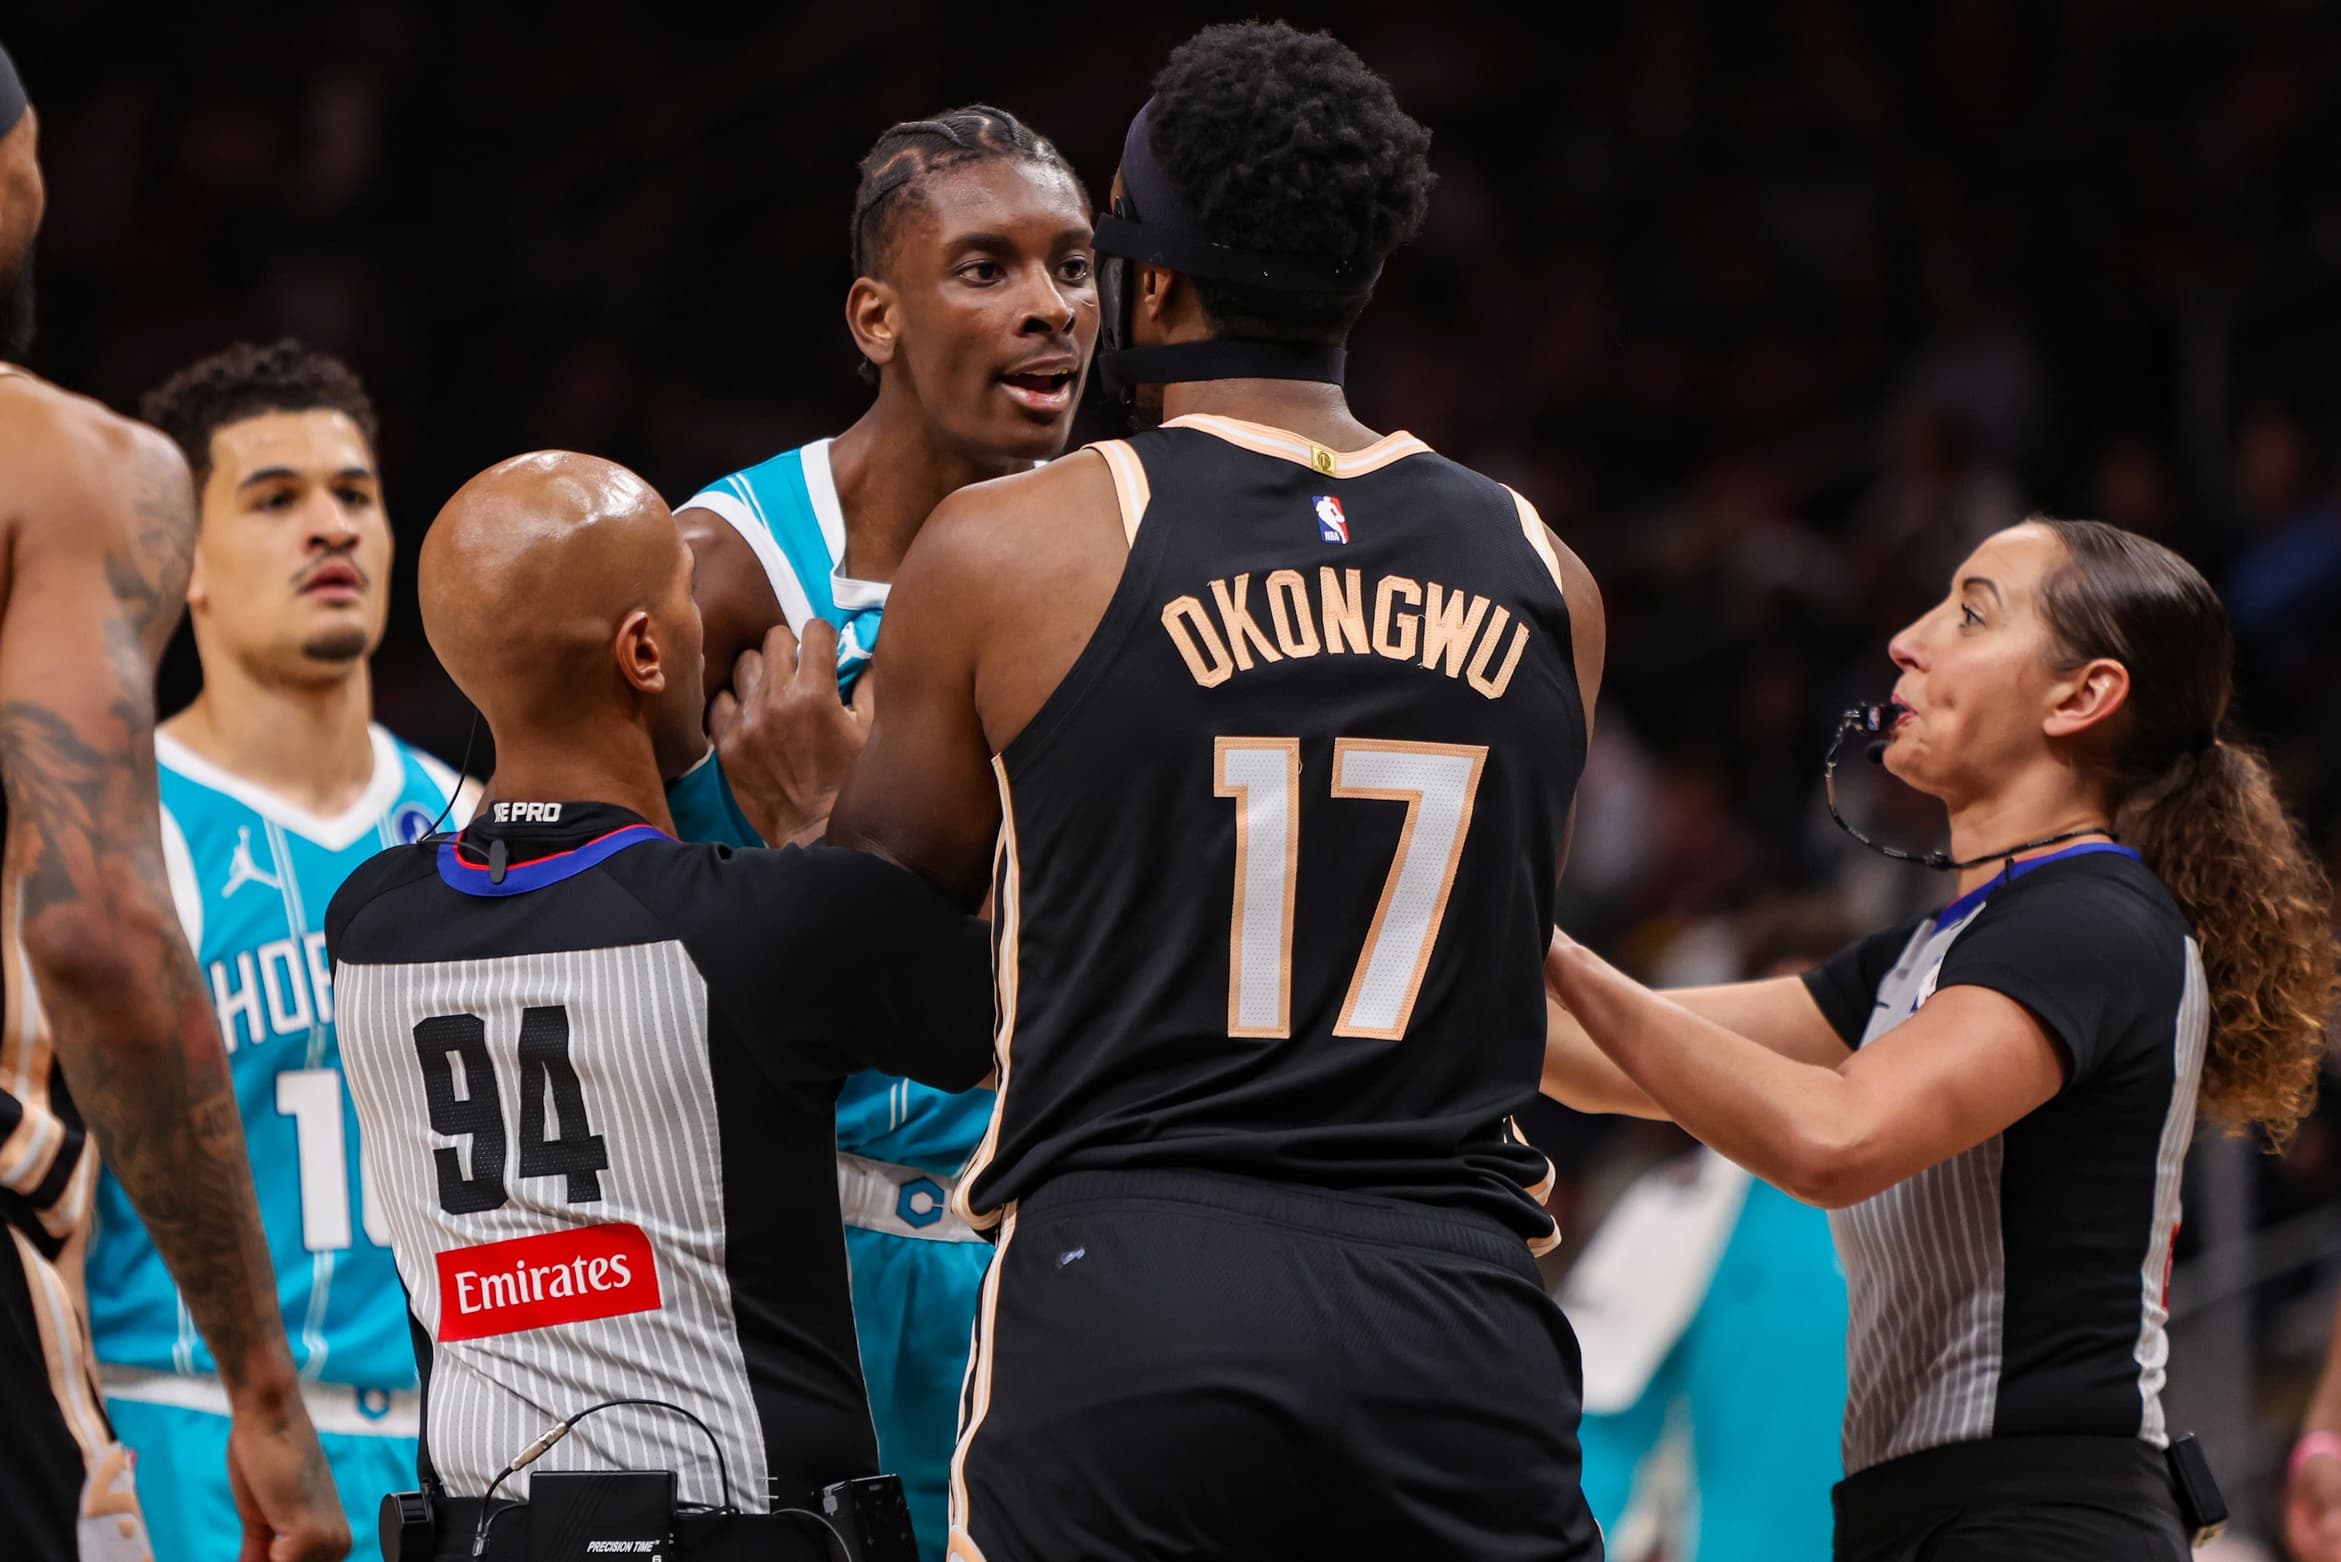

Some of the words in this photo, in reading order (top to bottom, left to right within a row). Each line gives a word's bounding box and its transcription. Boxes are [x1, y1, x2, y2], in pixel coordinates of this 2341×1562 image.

[1160, 566, 1530, 700] OKONGWU
[1213, 736, 1490, 1042] 17
[413, 1005, 609, 1215] 94
[454, 1253, 632, 1316] Emirates
[586, 1540, 634, 1553] PRECISION
